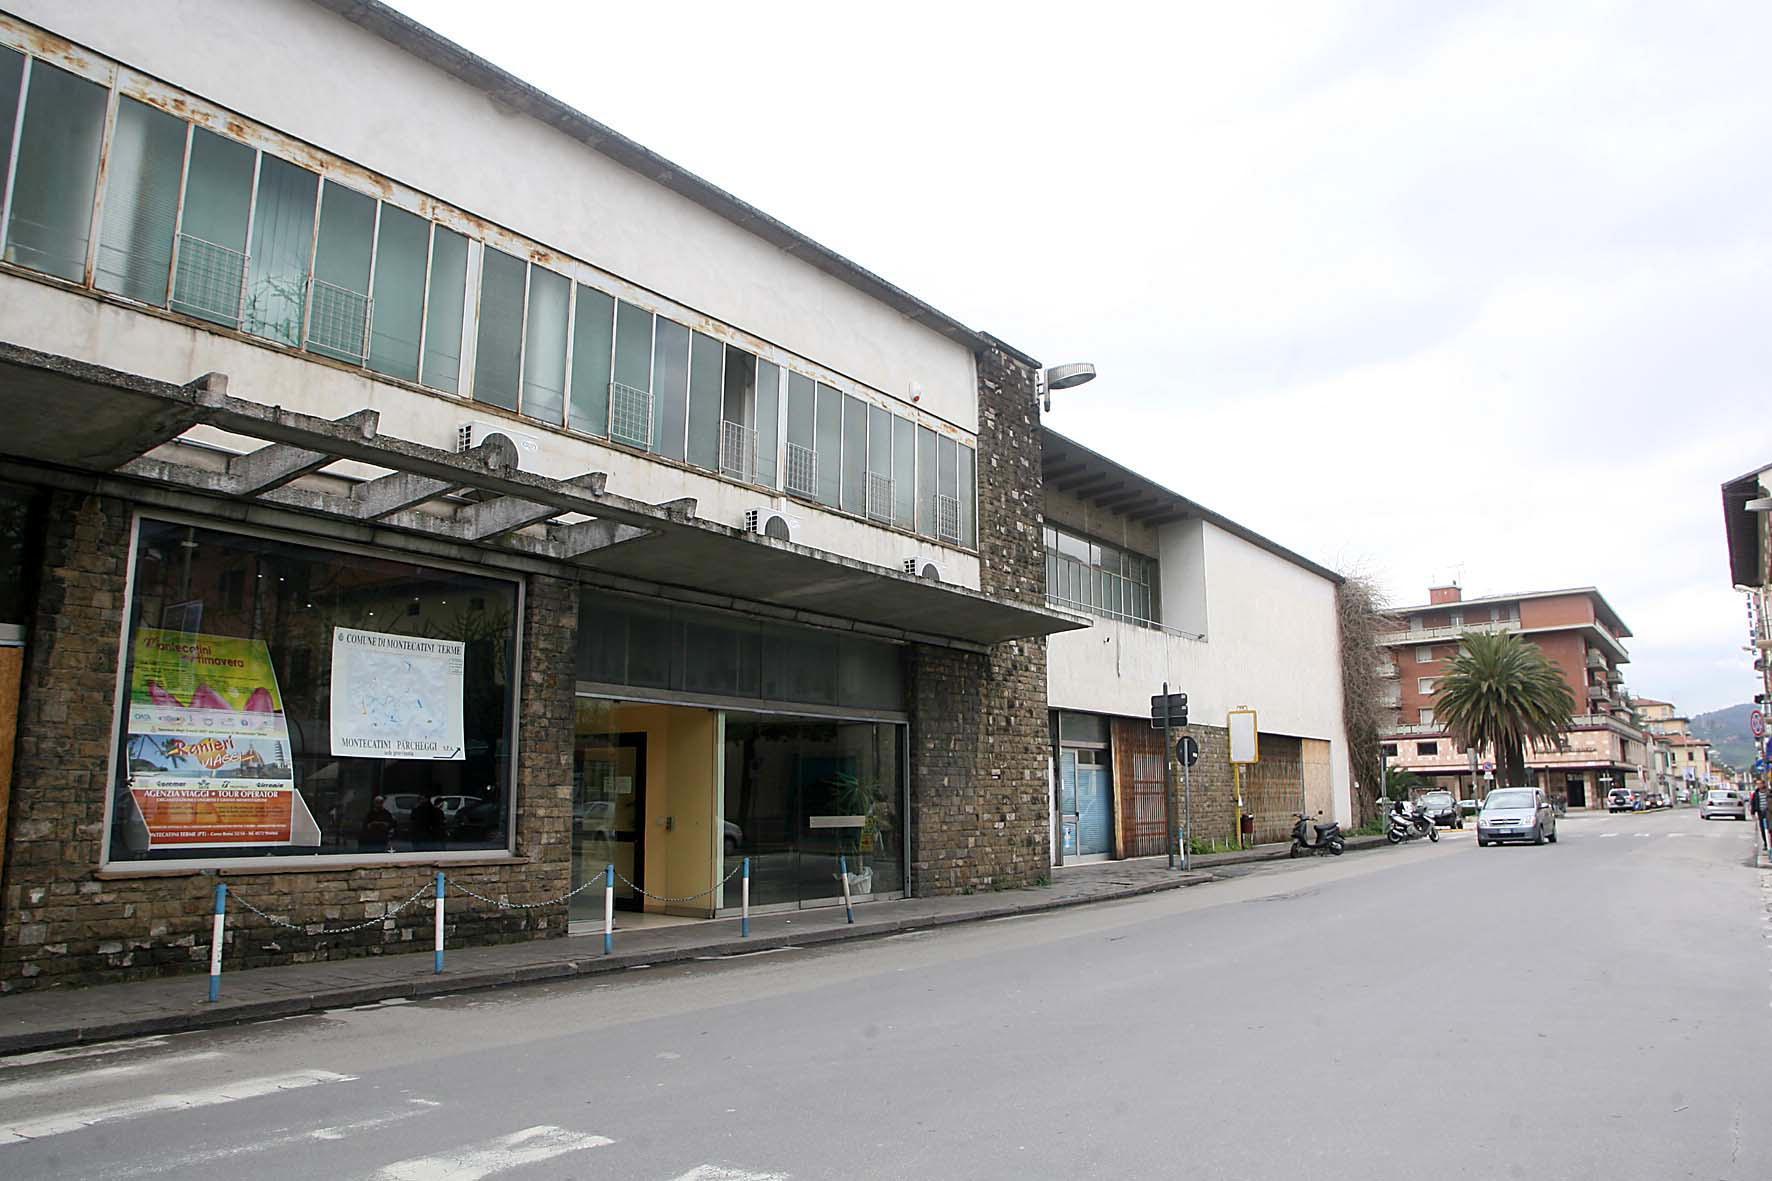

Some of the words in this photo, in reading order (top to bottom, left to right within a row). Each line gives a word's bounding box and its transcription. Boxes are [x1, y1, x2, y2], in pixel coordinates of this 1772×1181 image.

[346, 633, 377, 646] COMUNE
[378, 637, 386, 647] DI
[386, 638, 435, 653] MONTECATINI
[438, 645, 462, 655] TERME
[171, 735, 235, 757] Ranieri
[342, 737, 391, 749] MONTECATINI
[397, 740, 438, 751] PARCHEGGI
[218, 790, 239, 798] TOUR
